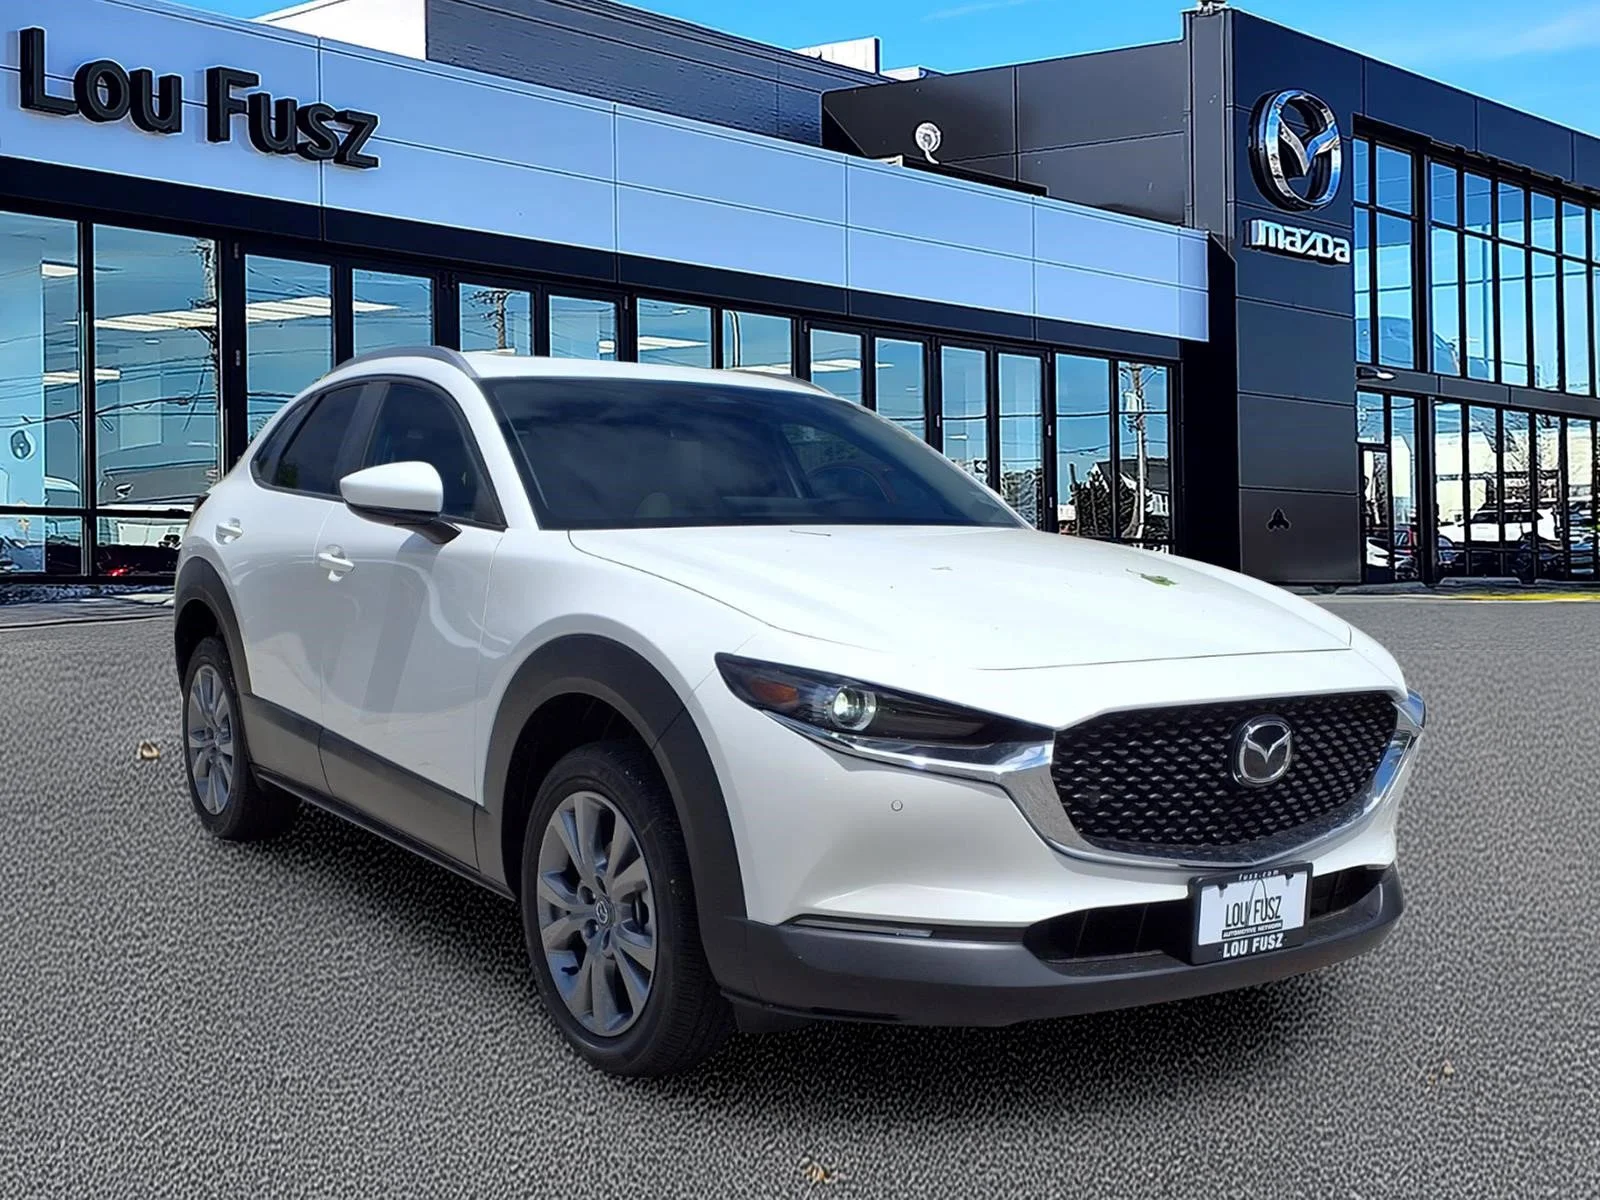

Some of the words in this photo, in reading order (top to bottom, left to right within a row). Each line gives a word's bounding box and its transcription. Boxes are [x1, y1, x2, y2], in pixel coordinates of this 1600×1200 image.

[19, 27, 182, 135] Lou
[206, 67, 379, 169] Fusz
[1225, 902, 1250, 928] LOU
[1253, 896, 1282, 923] FUSZ
[1223, 939, 1248, 958] LOU
[1252, 933, 1284, 953] FUSZ
